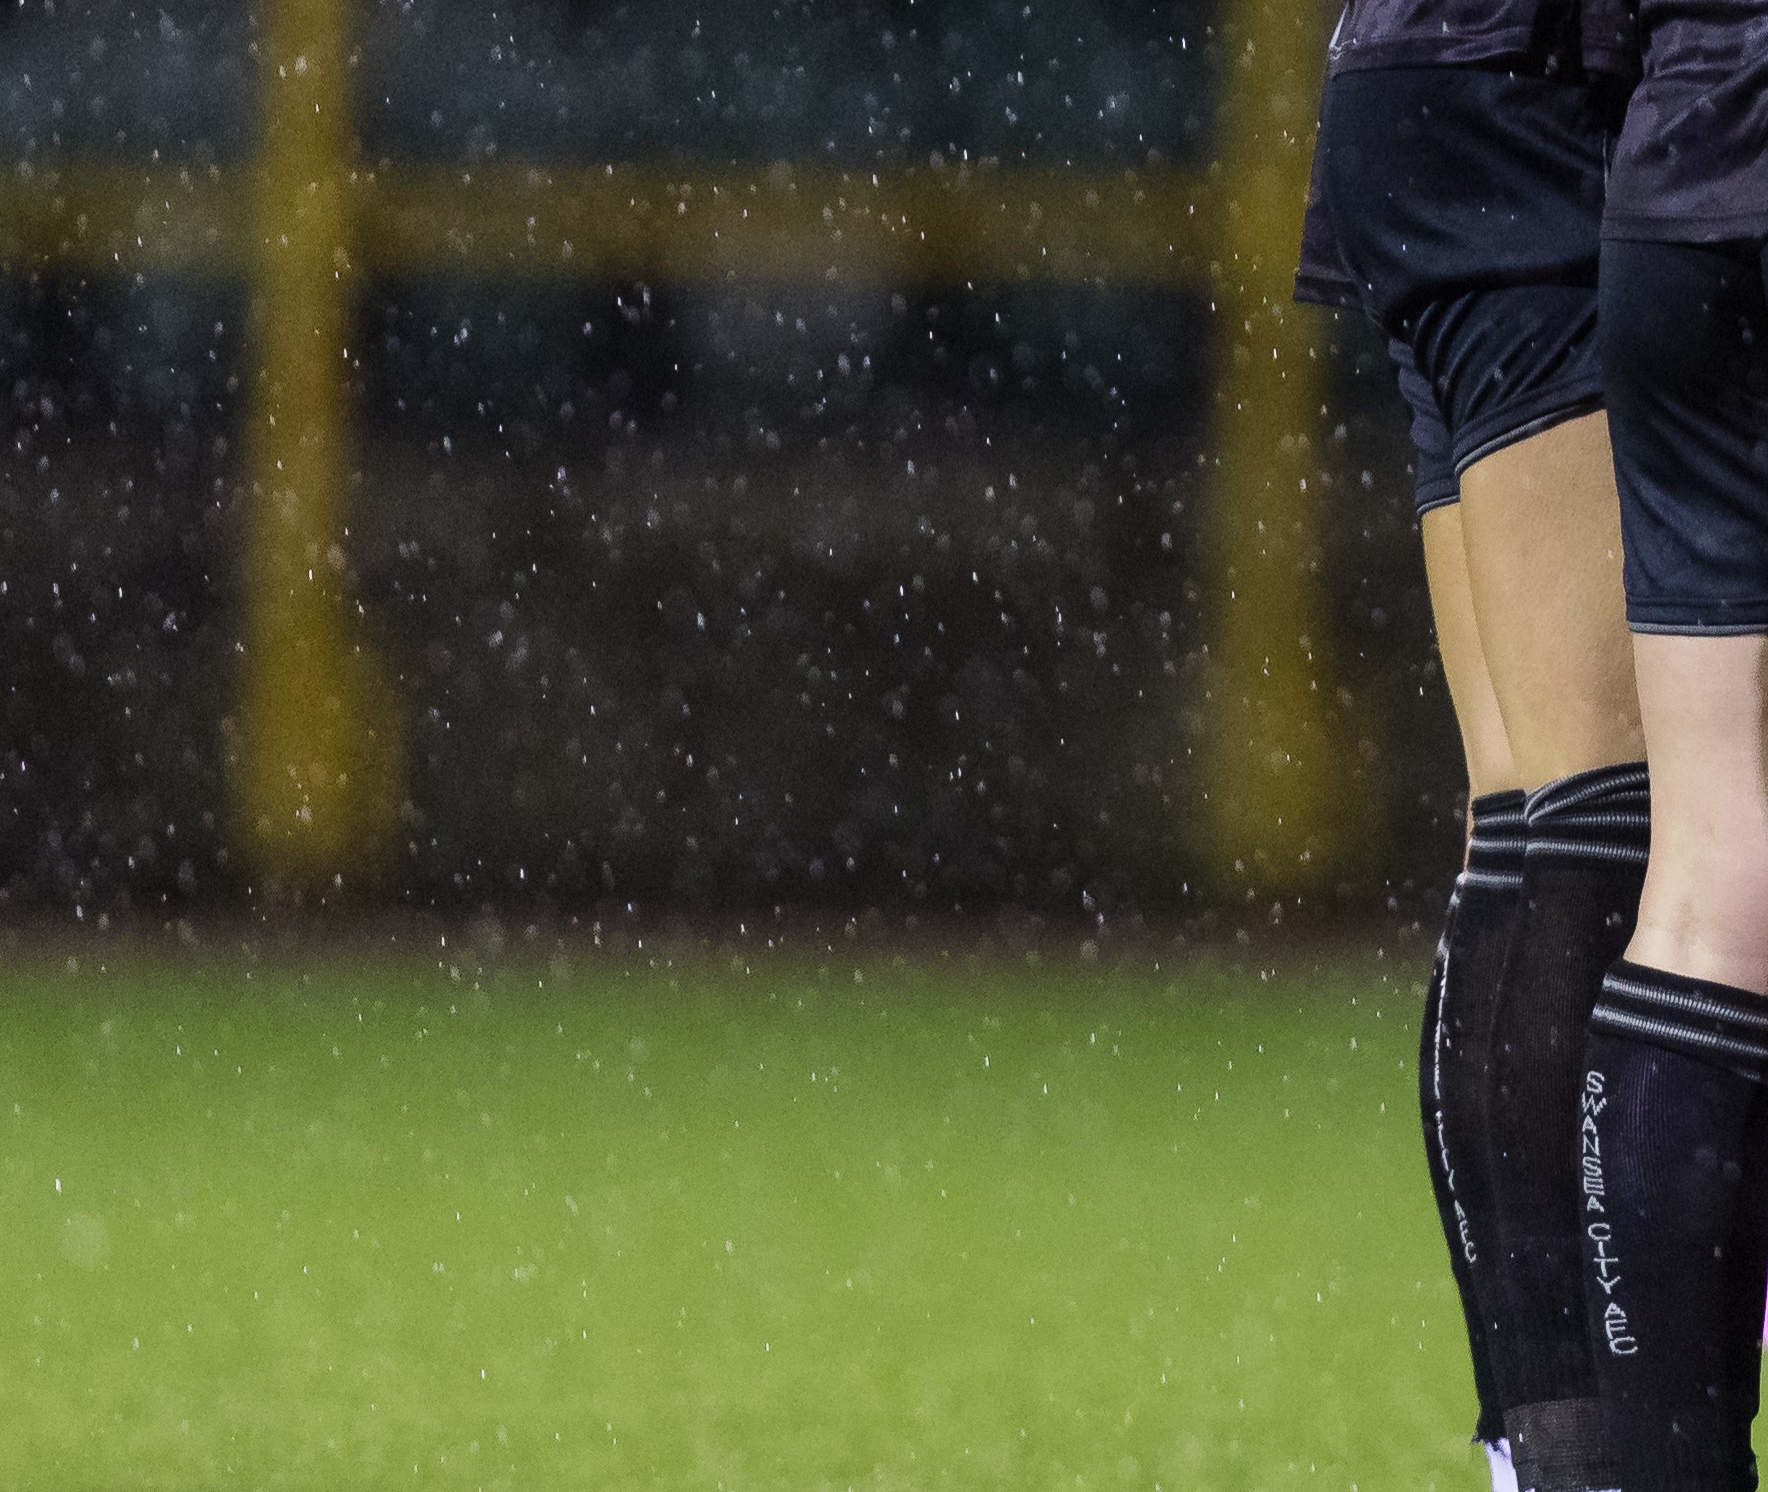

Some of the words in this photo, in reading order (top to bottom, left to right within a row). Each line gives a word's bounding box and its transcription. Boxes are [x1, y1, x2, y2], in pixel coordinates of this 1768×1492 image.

[1581, 1070, 1607, 1213] SWANSEA
[1587, 1223, 1621, 1294] CITY
[1604, 1302, 1638, 1354] AFC
